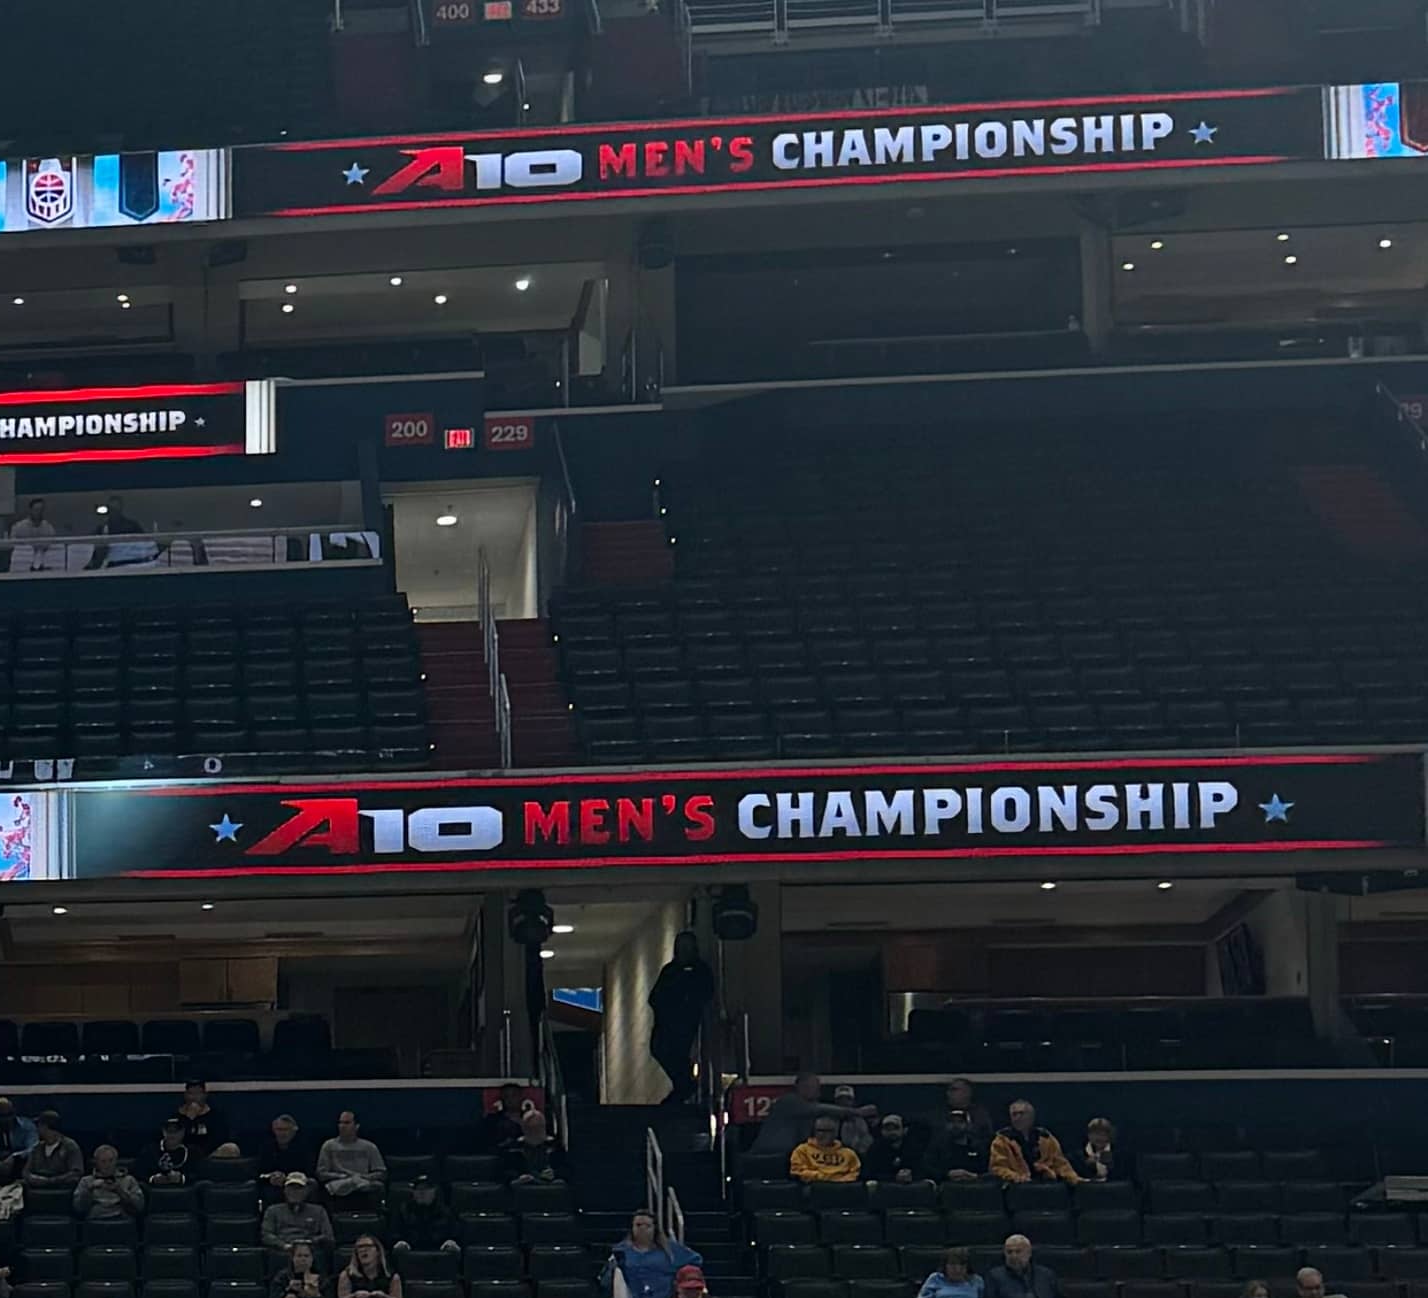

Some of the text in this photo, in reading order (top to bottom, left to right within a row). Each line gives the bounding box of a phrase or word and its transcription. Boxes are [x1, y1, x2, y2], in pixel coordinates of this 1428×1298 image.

[436, 4, 469, 20] 400
[372, 114, 1174, 195] A10 MEN'S CHAMPIONSHIP
[391, 421, 428, 438] 200
[491, 424, 528, 442] 229
[246, 783, 1238, 855] A10 MEN'S CHAMPIONSHIP
